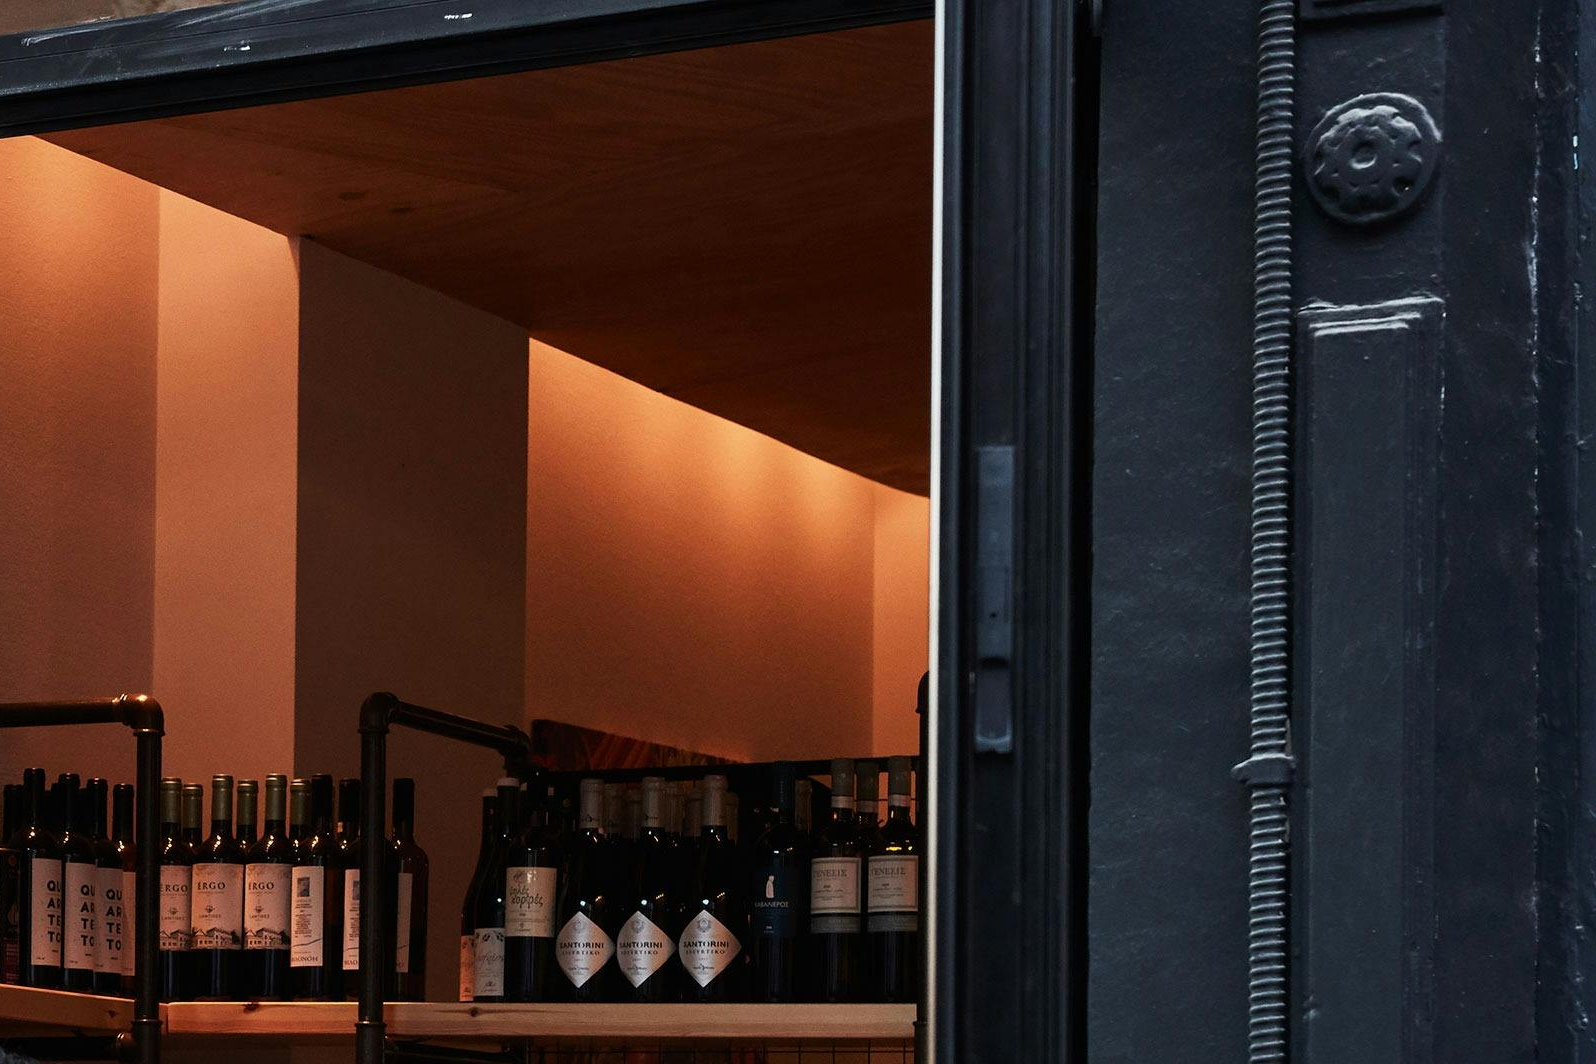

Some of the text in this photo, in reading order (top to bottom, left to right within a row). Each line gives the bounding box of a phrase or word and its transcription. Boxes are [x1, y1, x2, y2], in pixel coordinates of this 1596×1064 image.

[106, 889, 122, 900] QU
[106, 906, 122, 917] AR
[106, 922, 121, 934] TE
[106, 939, 122, 951] TO
